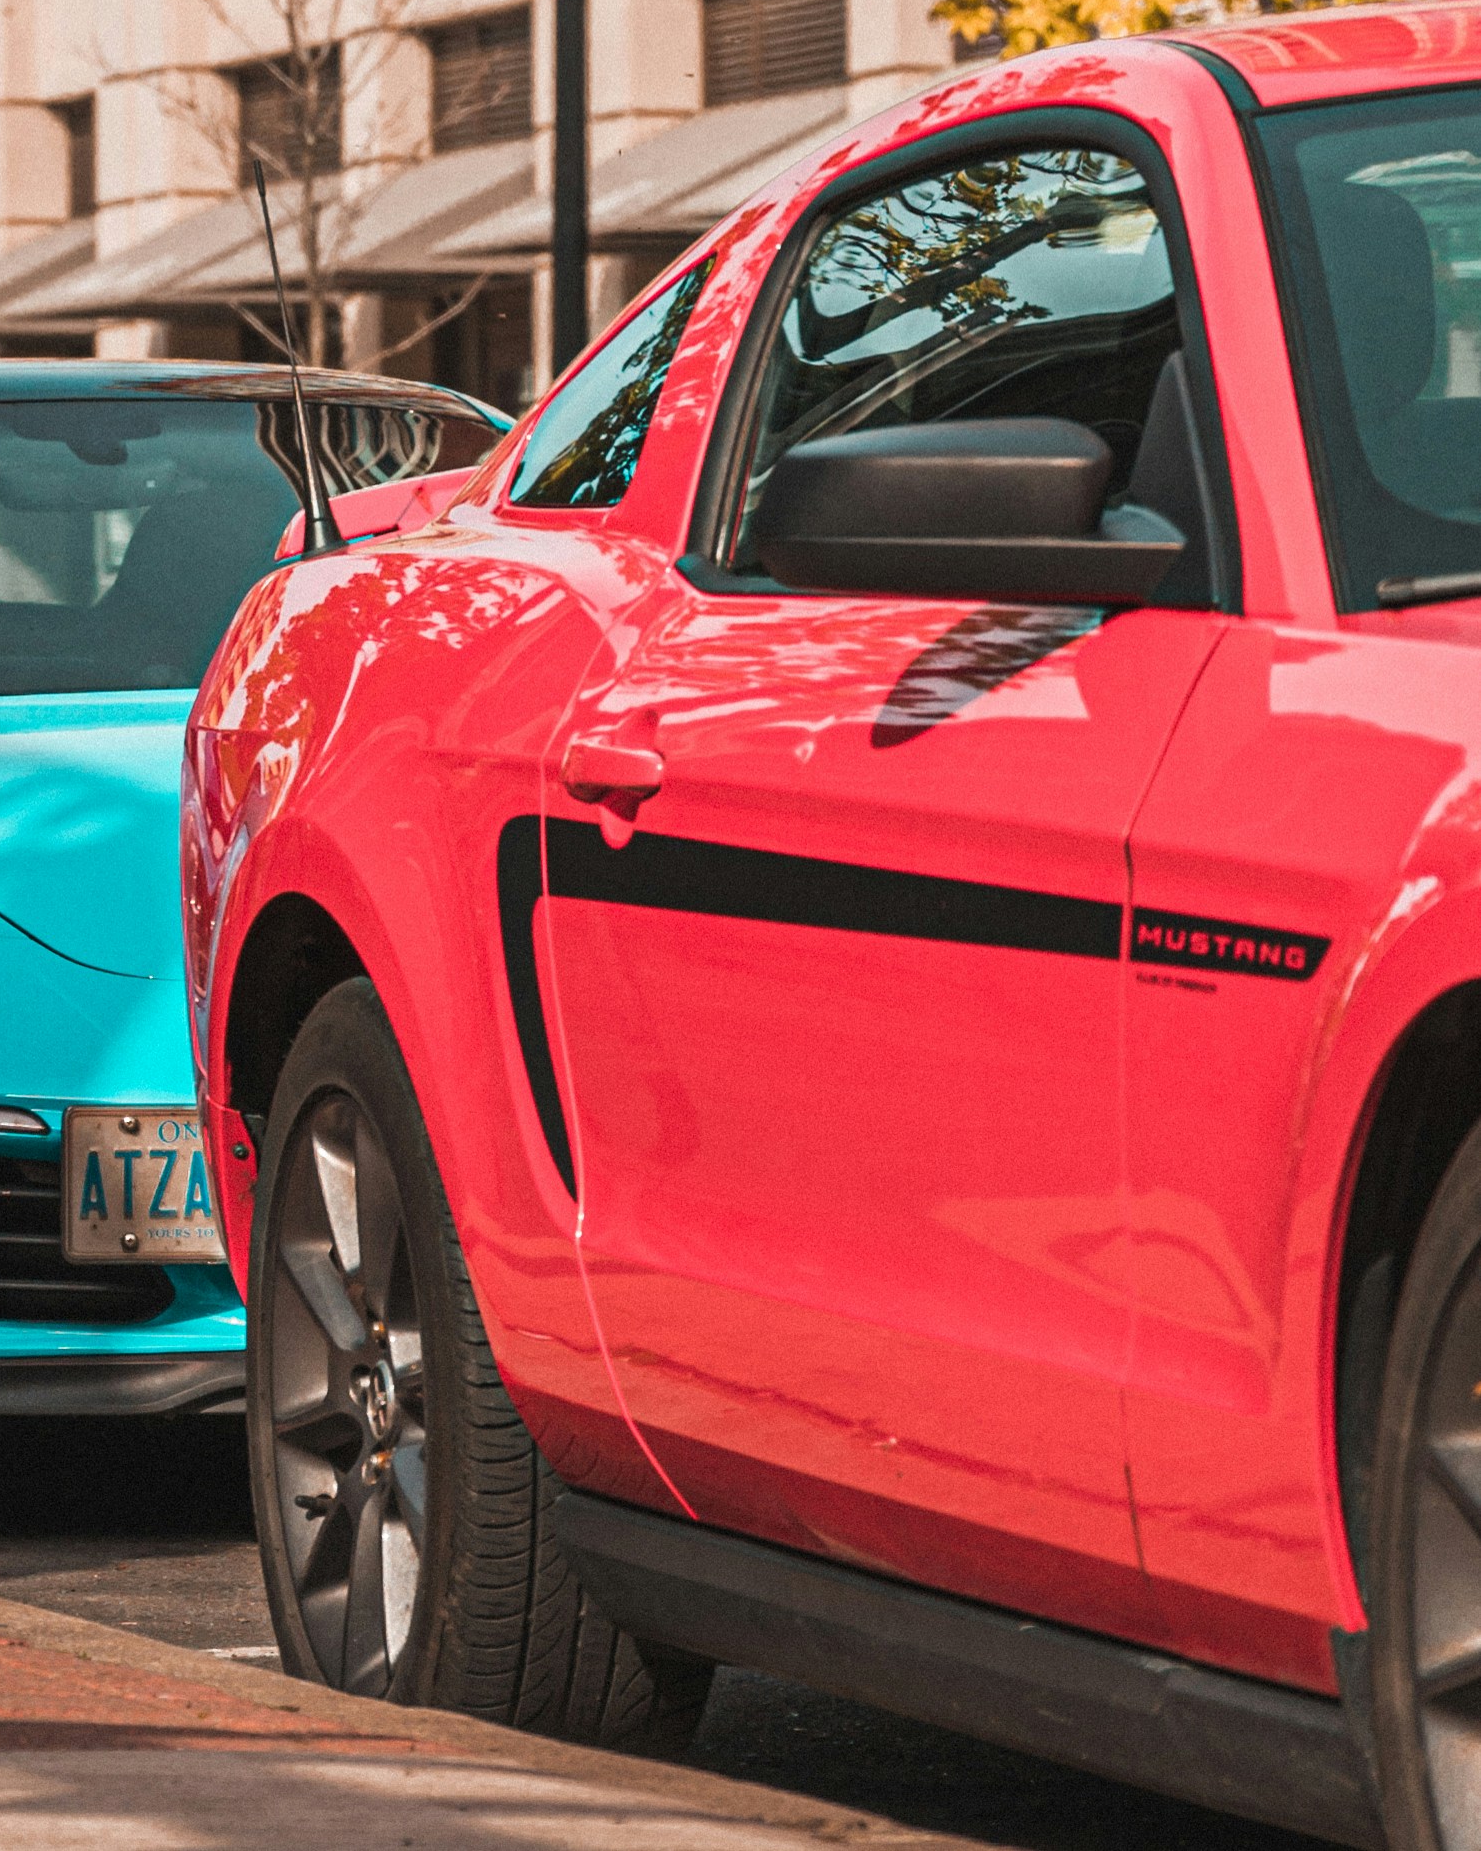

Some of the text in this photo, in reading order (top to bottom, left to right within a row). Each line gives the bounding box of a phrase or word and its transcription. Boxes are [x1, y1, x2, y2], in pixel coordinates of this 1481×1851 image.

[1138, 924, 1307, 971] MUSTANG
[80, 1150, 212, 1220] ATZA
[148, 1228, 215, 1239] YOURS TO
